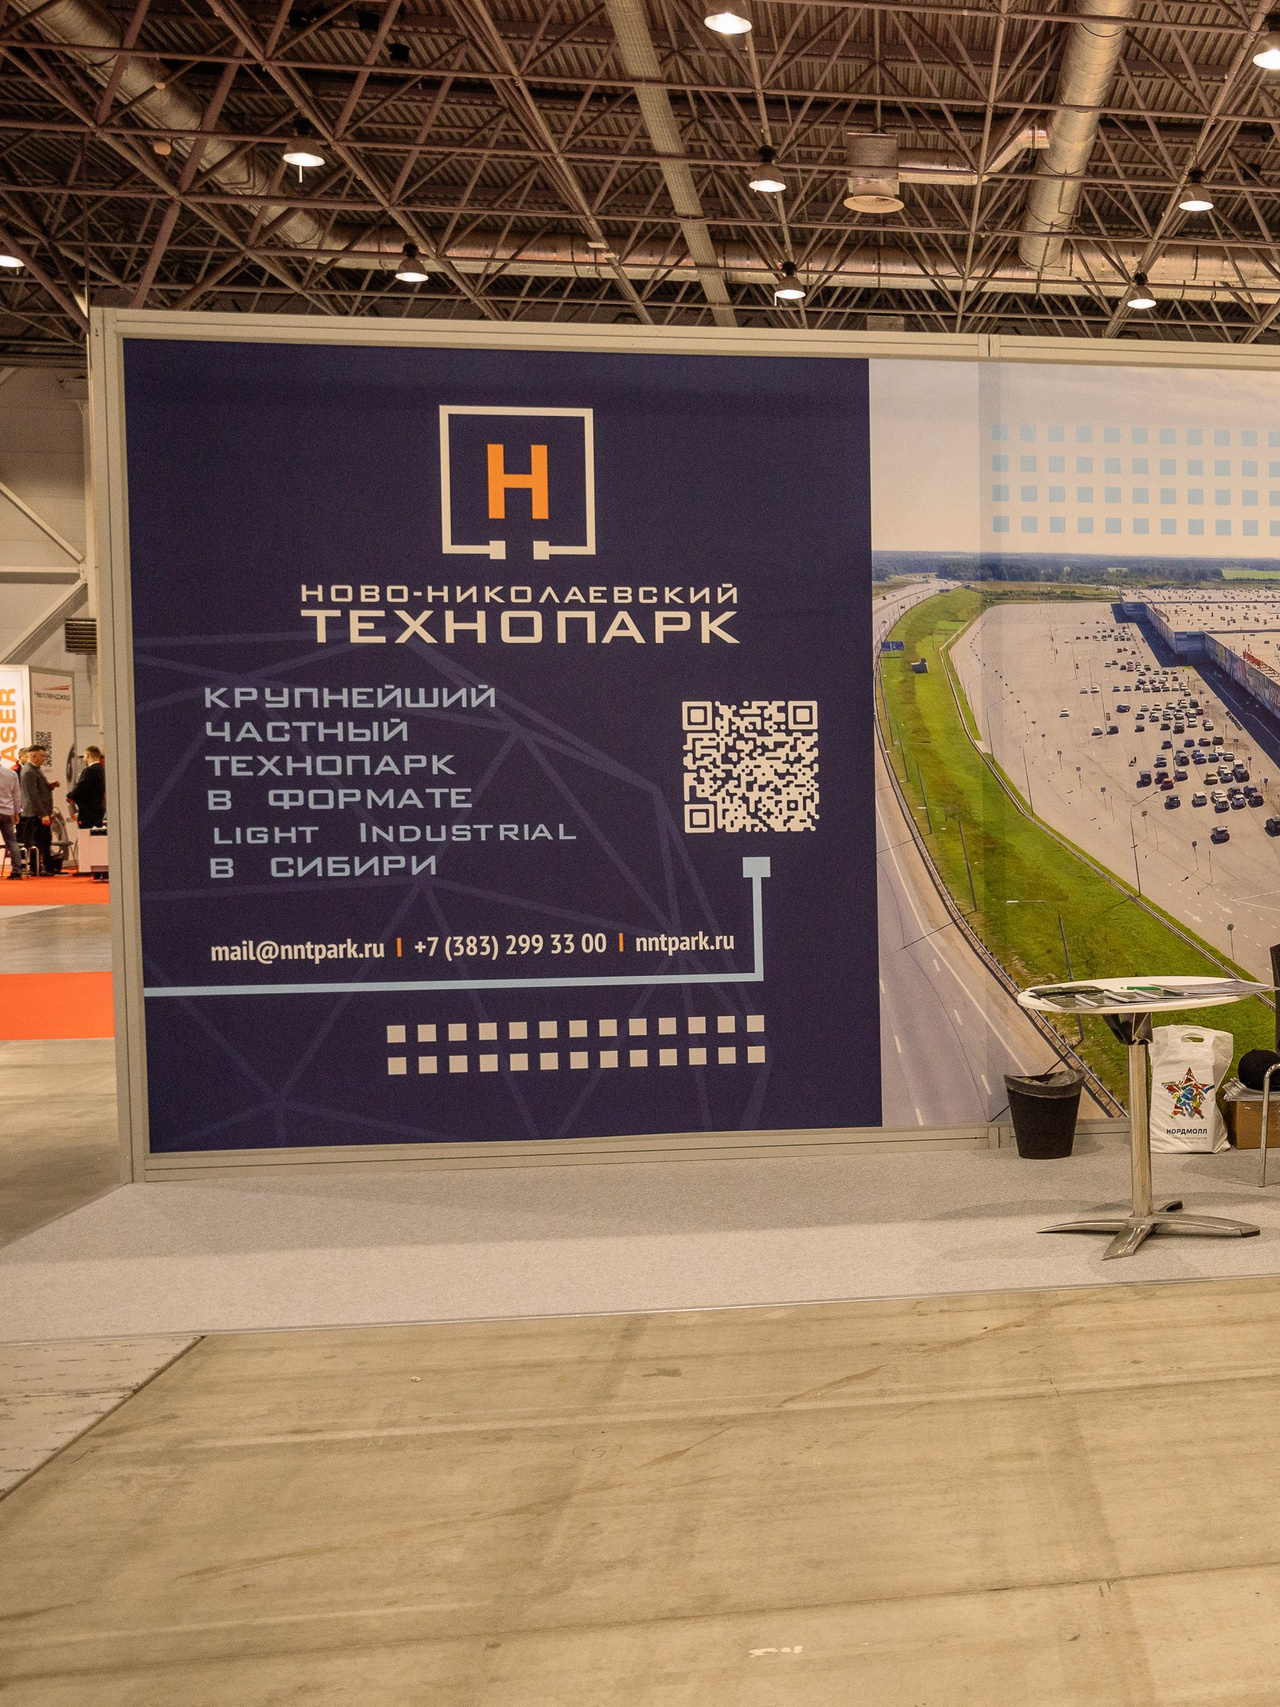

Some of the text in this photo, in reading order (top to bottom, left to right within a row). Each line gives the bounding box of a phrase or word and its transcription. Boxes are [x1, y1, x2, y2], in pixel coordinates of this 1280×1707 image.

[301, 583, 739, 605] НОВО-НИКОЛАЕВСКИЙ
[301, 610, 741, 645] ТЕХНОПАРК
[204, 684, 497, 710] КРУПНЕЙШИЙ
[0, 688, 17, 763] ASER
[206, 718, 409, 743] ЧАСТНЫЙ
[206, 755, 457, 777] ТЕХНОПАРК
[208, 788, 474, 811] В ФОРМАТЕ
[210, 855, 437, 879] В СИБИРИ
[210, 931, 735, 966] mail@nntpark.ru +7 (383) 299 33 00 nntpark.ru
[1166, 1128, 1208, 1136] НОРДМОЛЛ
